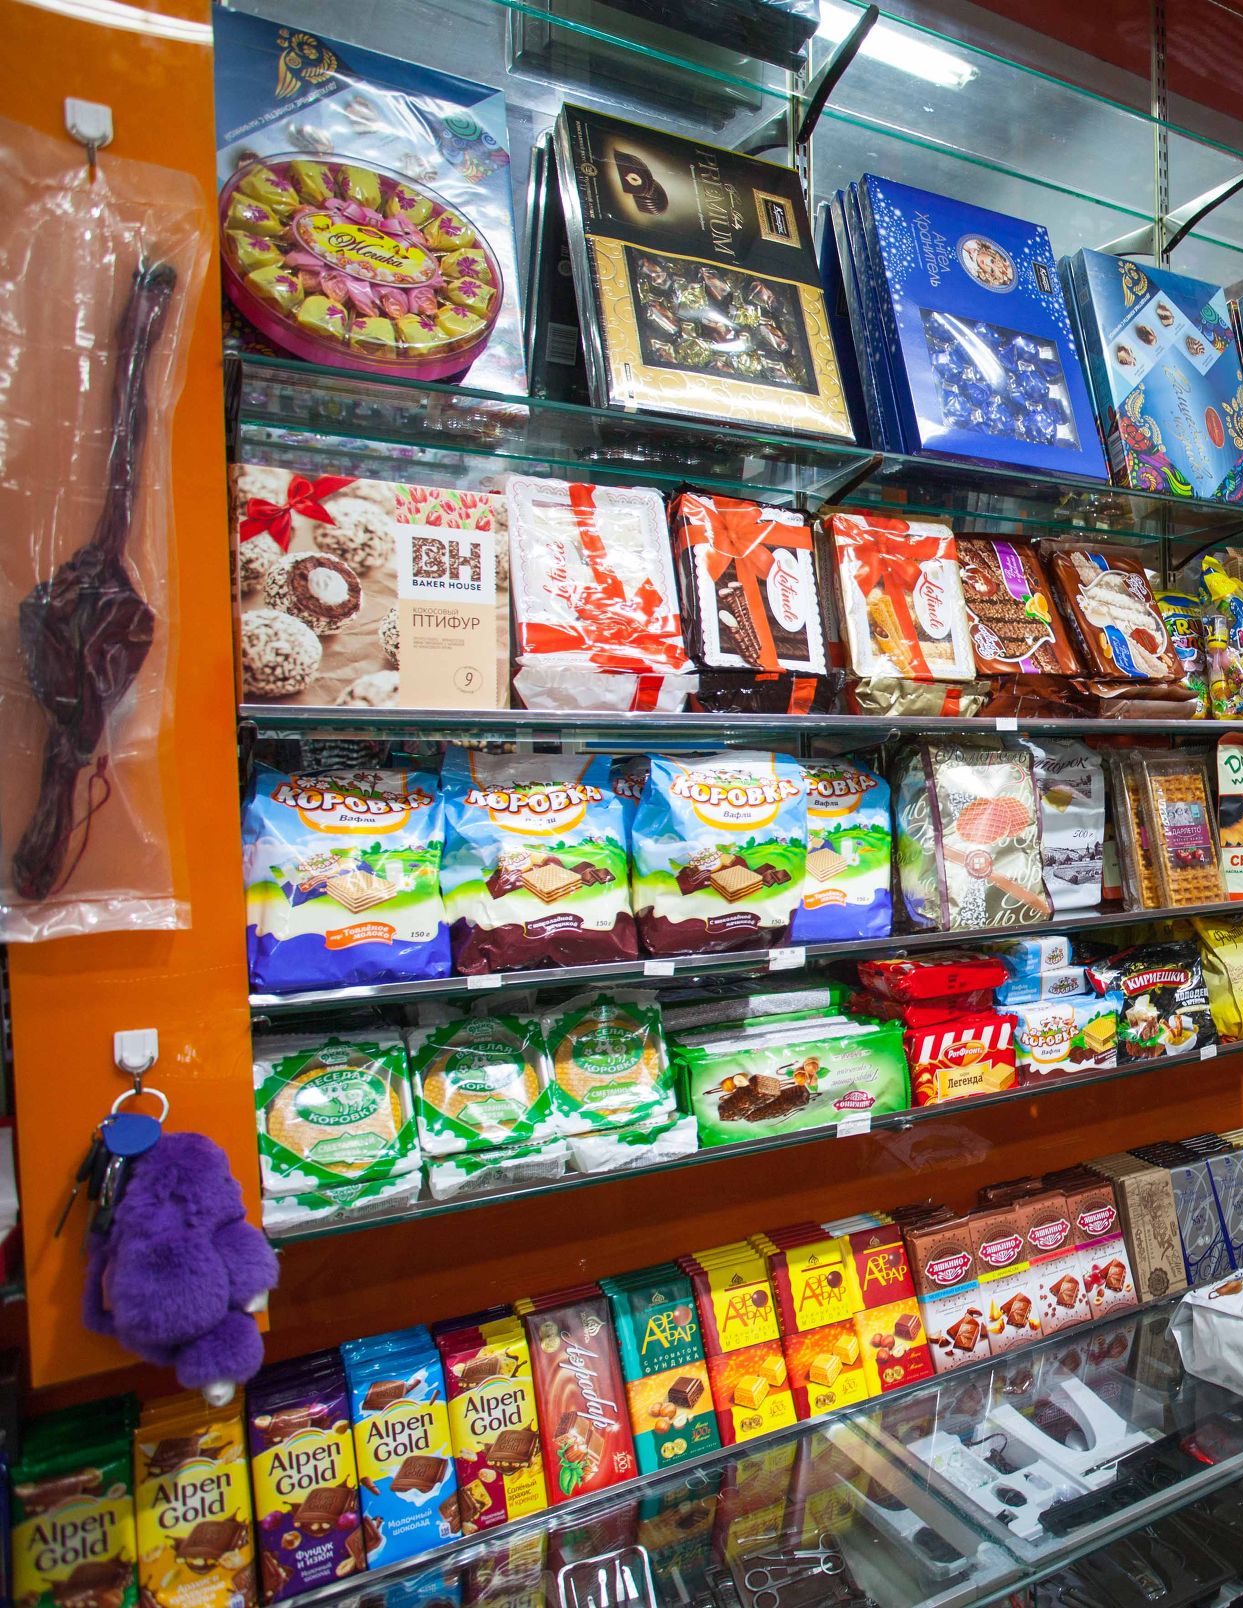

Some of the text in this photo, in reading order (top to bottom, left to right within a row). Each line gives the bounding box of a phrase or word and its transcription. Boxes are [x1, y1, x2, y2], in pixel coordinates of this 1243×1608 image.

[913, 210, 941, 288] Хранитель
[931, 231, 951, 272] Ангел
[412, 536, 482, 583] BH
[412, 579, 482, 591] BAKER HOUSE
[412, 614, 481, 630] ПТИФУР
[672, 778, 800, 808] КОРОВКА
[807, 775, 876, 797] РОВКА
[276, 785, 431, 812] КОРОВКА
[814, 799, 839, 808] Вафли
[339, 813, 377, 824] Вафли
[723, 810, 752, 820] Вафли
[1127, 971, 1186, 991] КИРИЕШКИ
[1021, 1024, 1081, 1048] КОРОВКА
[455, 1044, 514, 1061] ВЕСЕЛАЯ
[583, 1057, 640, 1074] КОРОВКА
[306, 1072, 373, 1090] ВЕСЕЛАЯ
[947, 1072, 984, 1090] Легенда
[308, 1103, 378, 1126] КОРОВКА
[1083, 1210, 1110, 1224] ЯШКИНО
[1034, 1224, 1064, 1239] ЯШКИНО
[986, 1239, 1016, 1255] ЯШКИНО
[933, 1258, 965, 1272] ЯШКИНО
[645, 1353, 699, 1374] ФУНДУКА
[653, 1346, 698, 1364] АРОМАТОМ
[464, 1388, 526, 1419] Alpen
[366, 1411, 434, 1445] Alpen
[470, 1405, 522, 1437] Gold
[373, 1429, 430, 1463] Gold
[268, 1441, 341, 1477] Alpen
[275, 1459, 337, 1496] Gold
[506, 1479, 538, 1496] Солёный
[151, 1472, 232, 1509] Alpen
[158, 1492, 225, 1530] Gold
[388, 1508, 433, 1529] Молочный
[28, 1510, 117, 1550] Alpen
[392, 1519, 431, 1536] шоколад
[35, 1531, 109, 1572] Gold
[295, 1541, 334, 1561] Фундук
[305, 1550, 334, 1567] изюм
